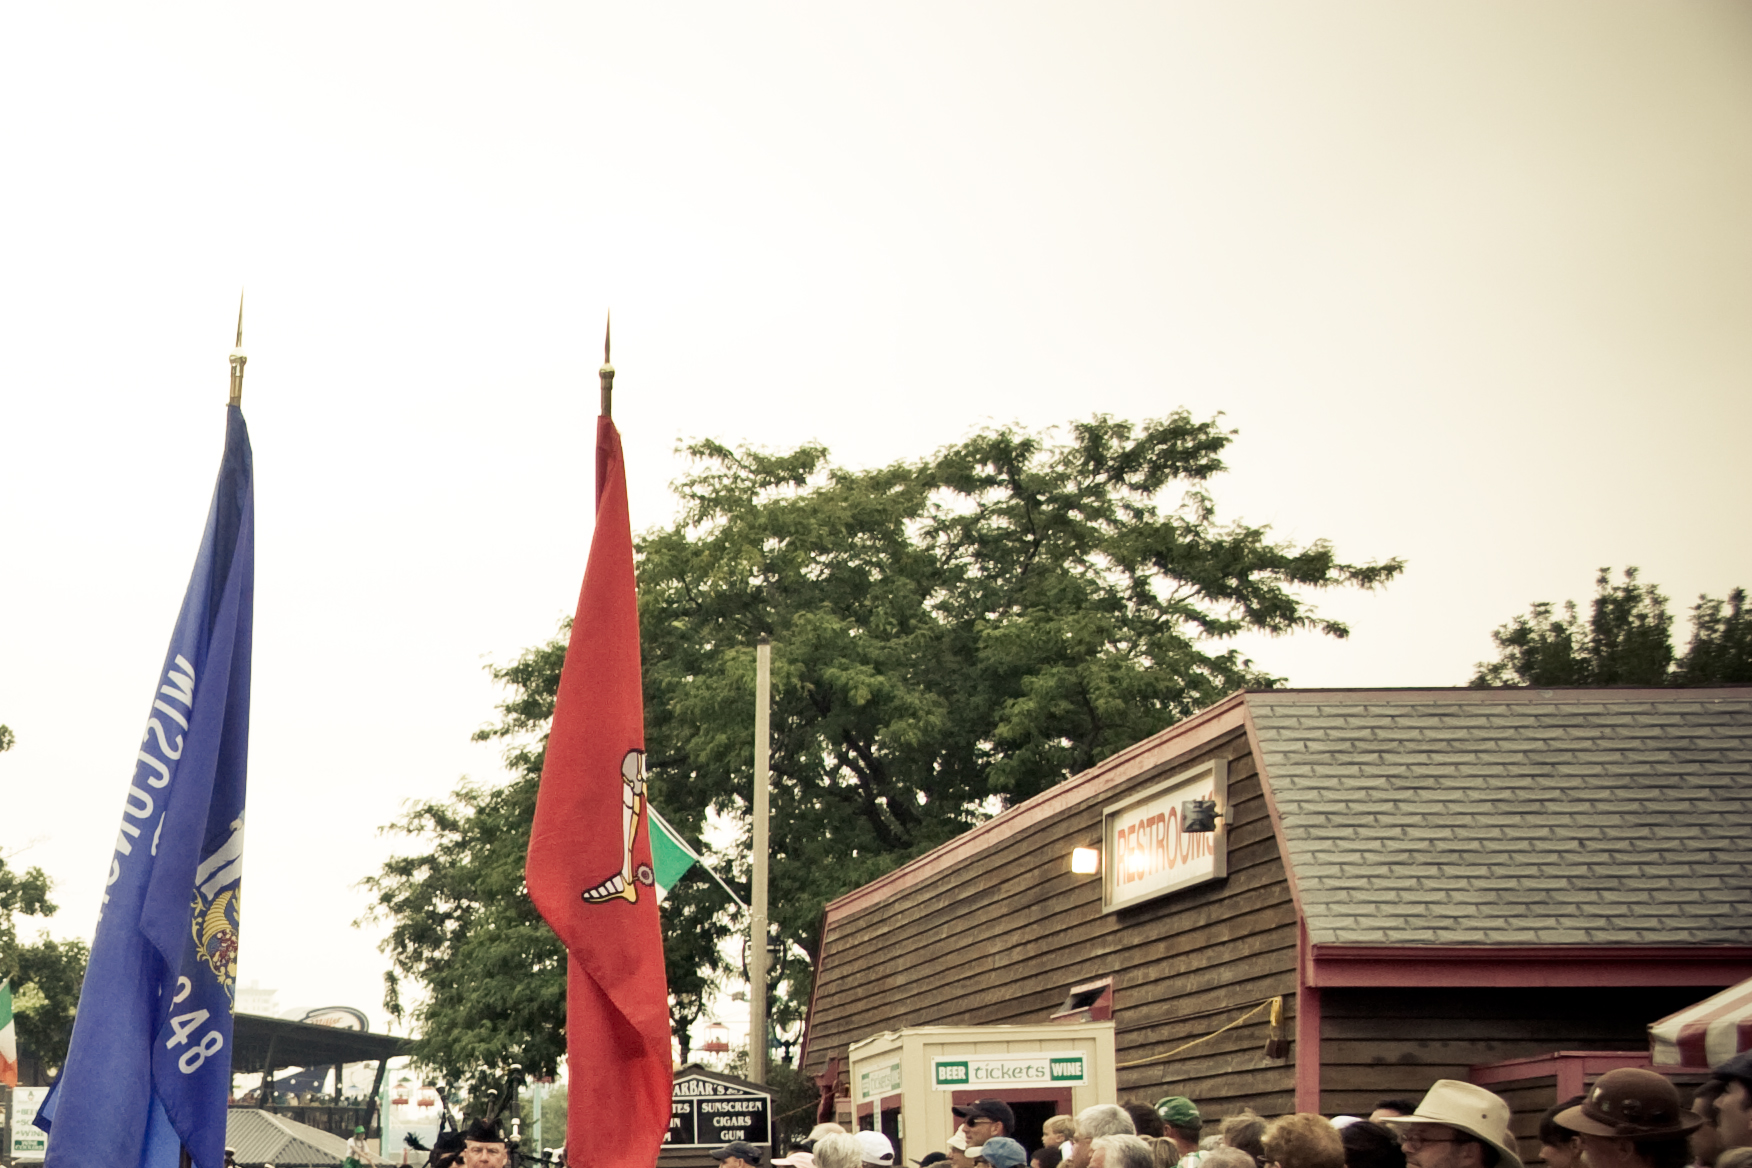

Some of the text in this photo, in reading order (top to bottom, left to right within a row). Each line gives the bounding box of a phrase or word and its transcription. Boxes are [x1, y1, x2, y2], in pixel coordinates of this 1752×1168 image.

[937, 1062, 1083, 1081] BEER tickets WINE
[673, 1080, 725, 1096] ARBAR'S
[701, 1101, 763, 1113] SUNSCREEN
[712, 1115, 752, 1127] CIGARS
[720, 1130, 745, 1140] GUM
